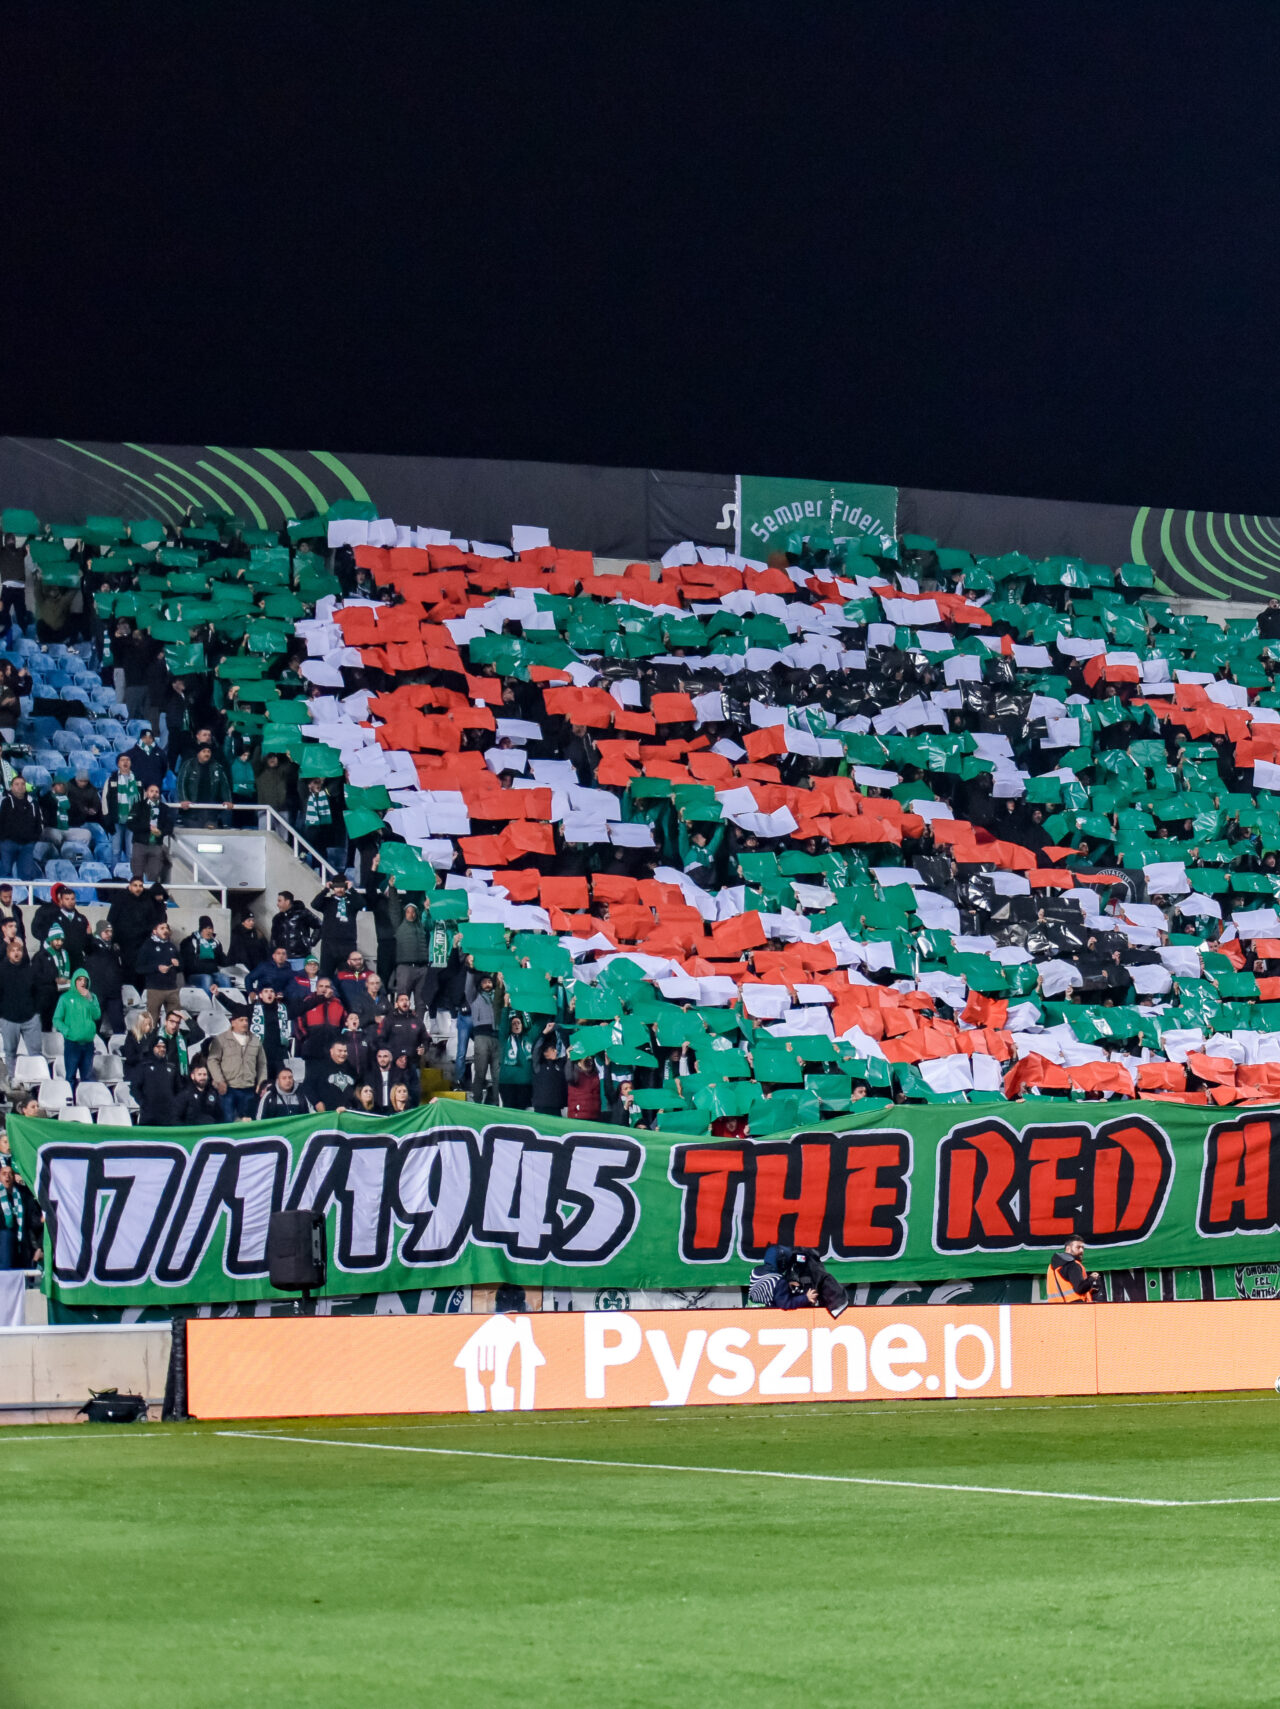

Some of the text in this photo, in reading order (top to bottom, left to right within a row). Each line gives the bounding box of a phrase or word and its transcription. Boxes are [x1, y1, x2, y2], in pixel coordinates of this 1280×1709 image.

[751, 500, 823, 543] Semper
[831, 499, 886, 537] Fideli
[671, 1130, 908, 1260] THE
[936, 1119, 1174, 1252] RED
[584, 1305, 1012, 1406] Pyszne.pl
